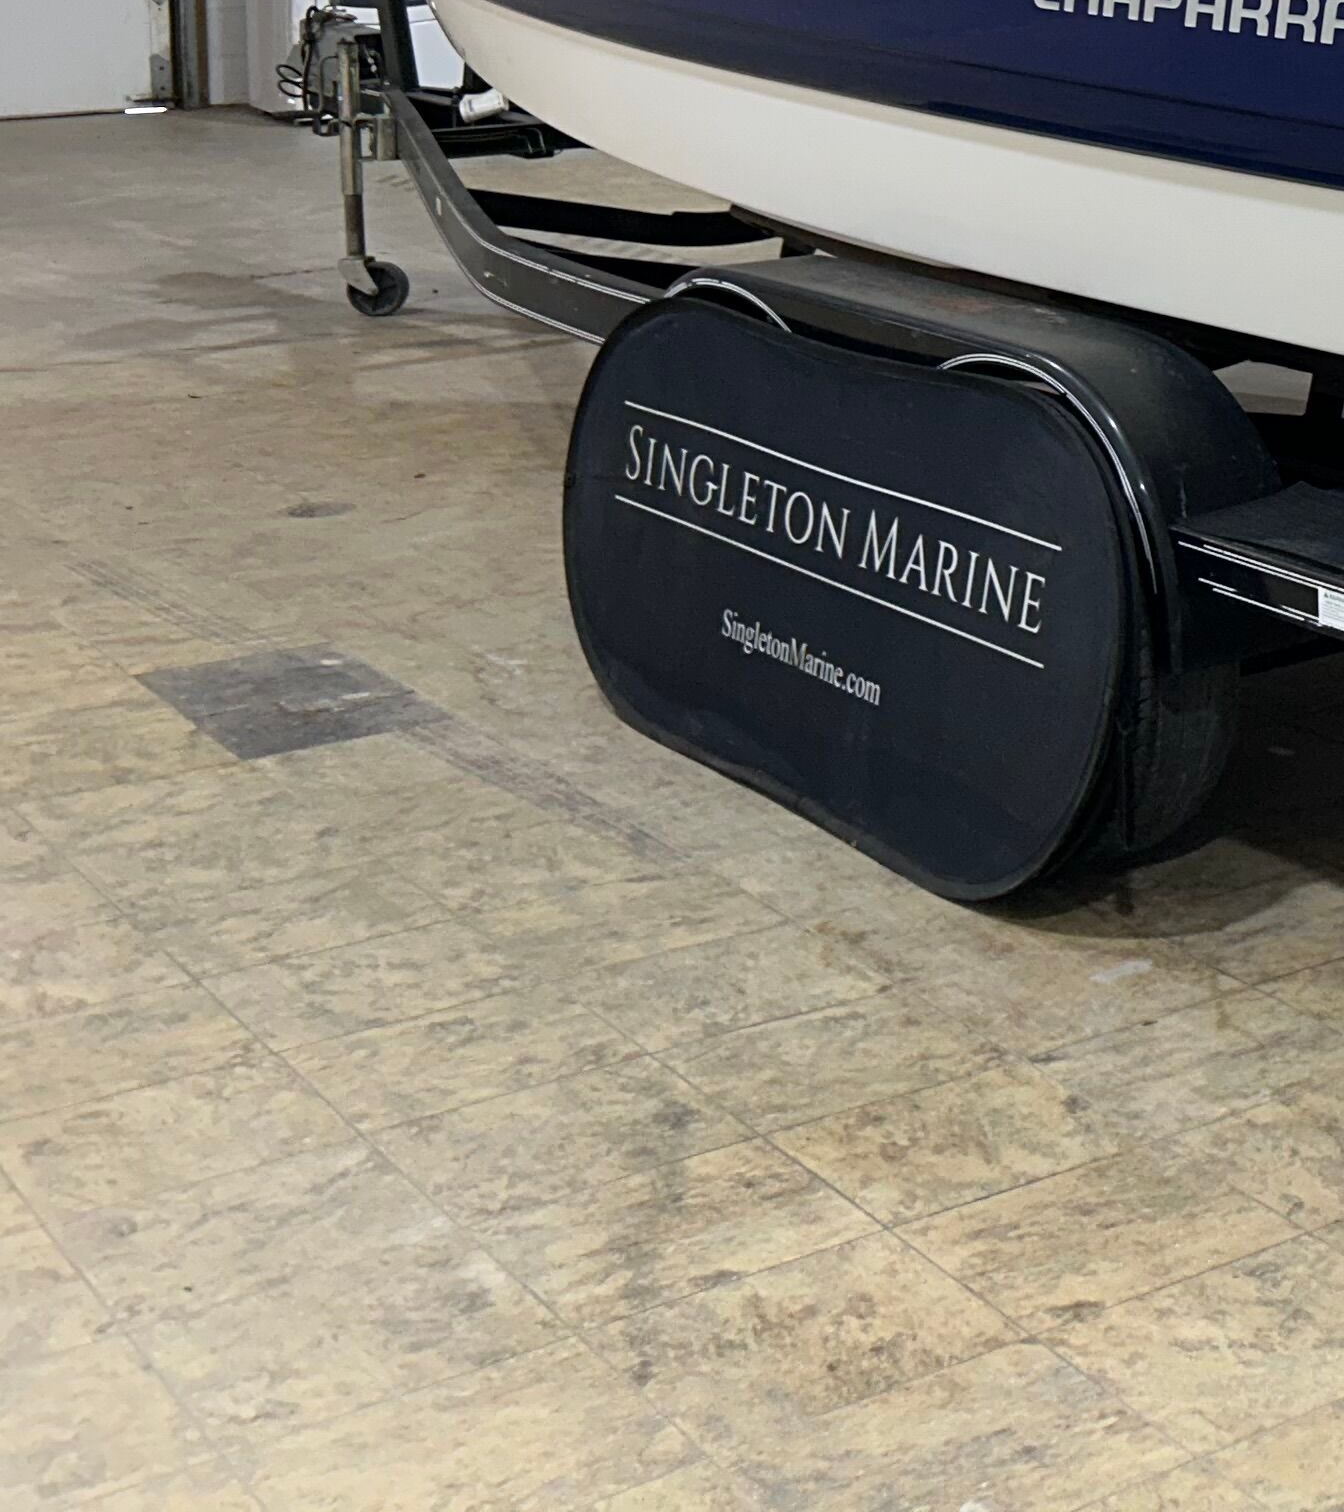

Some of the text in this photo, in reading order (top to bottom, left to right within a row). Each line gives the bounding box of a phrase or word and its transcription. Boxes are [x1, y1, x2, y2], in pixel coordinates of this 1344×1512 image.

[624, 424, 1047, 635] SINGLETON MARINE
[721, 608, 882, 706] SingletonMarine.com
